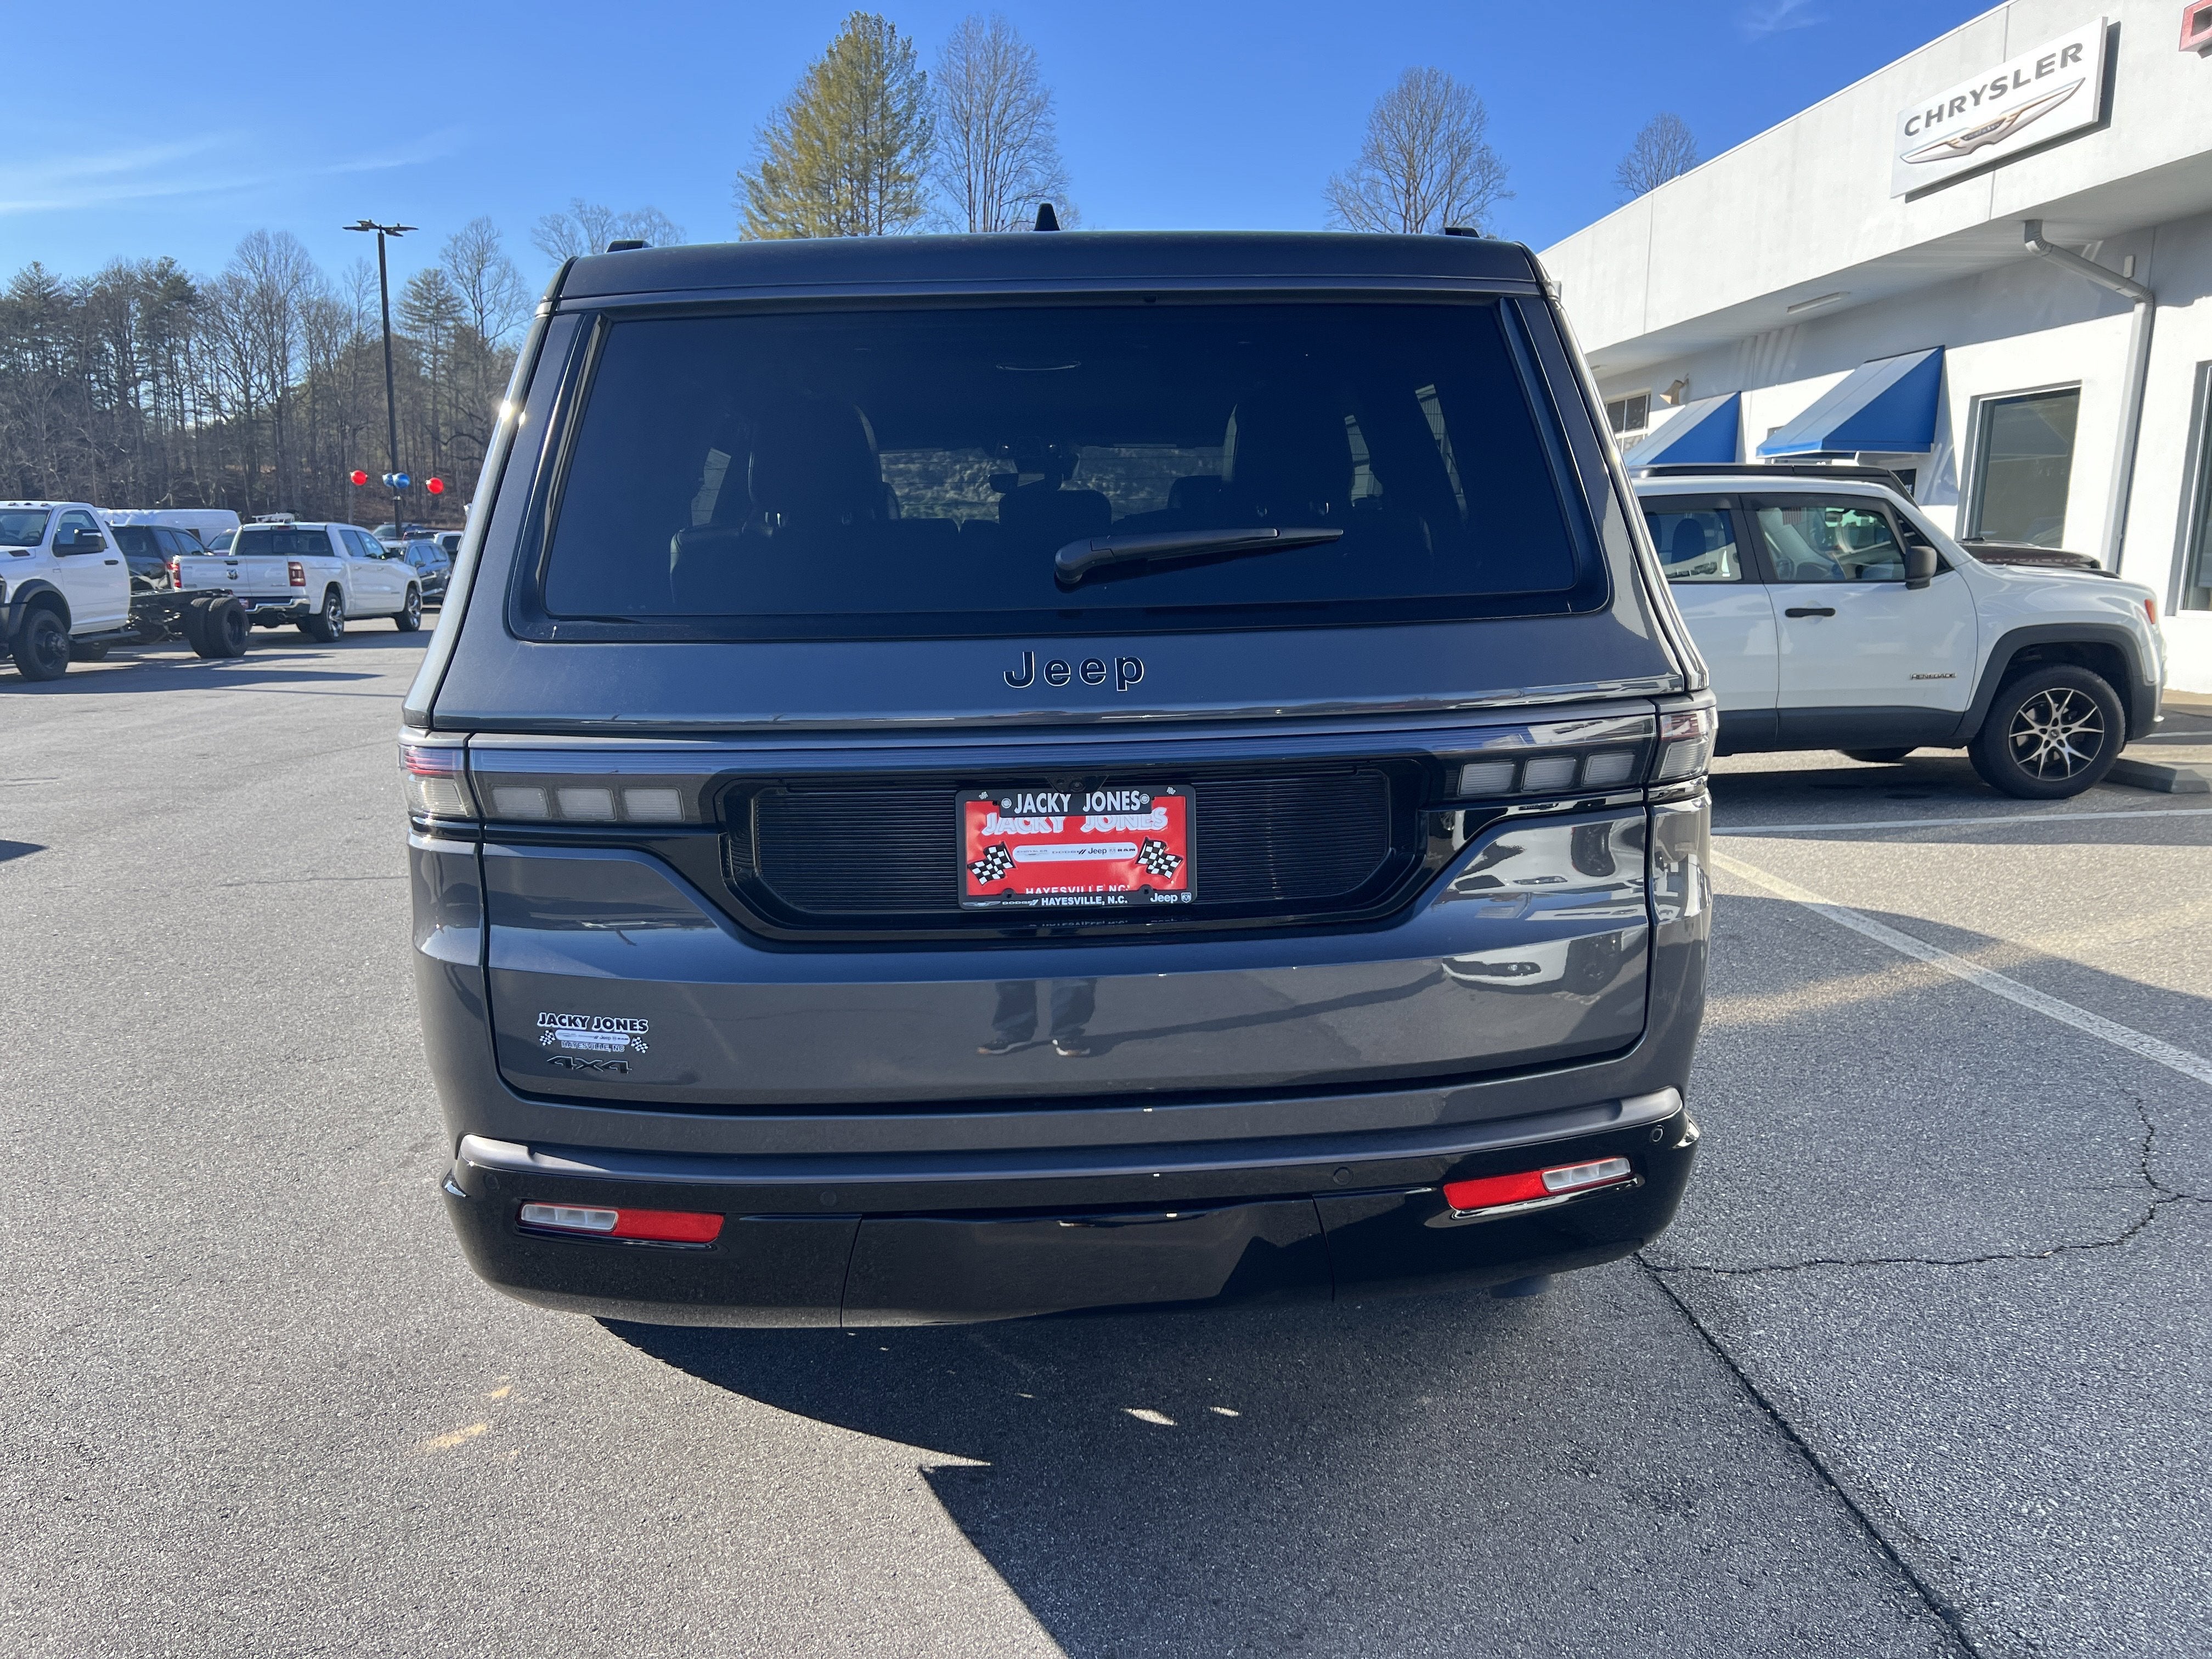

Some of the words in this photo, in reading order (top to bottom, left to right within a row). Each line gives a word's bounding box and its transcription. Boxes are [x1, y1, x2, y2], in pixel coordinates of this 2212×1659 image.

[1904, 42, 2083, 137] CHRYSLER
[1003, 650, 1144, 692] Jeep
[1014, 792, 1071, 814] JACKY
[1082, 790, 1141, 812] JONES
[981, 812, 1066, 836] JACKY
[1080, 807, 1168, 833] JONES
[1041, 895, 1105, 906] HAYESVILLE,
[1107, 895, 1128, 904] N.C.
[1150, 892, 1178, 904] Jeep
[537, 1012, 590, 1029] JACKY
[592, 1016, 649, 1035] JONES
[561, 1040, 612, 1053] HAYESVILLE,
[612, 1044, 625, 1052] NC
